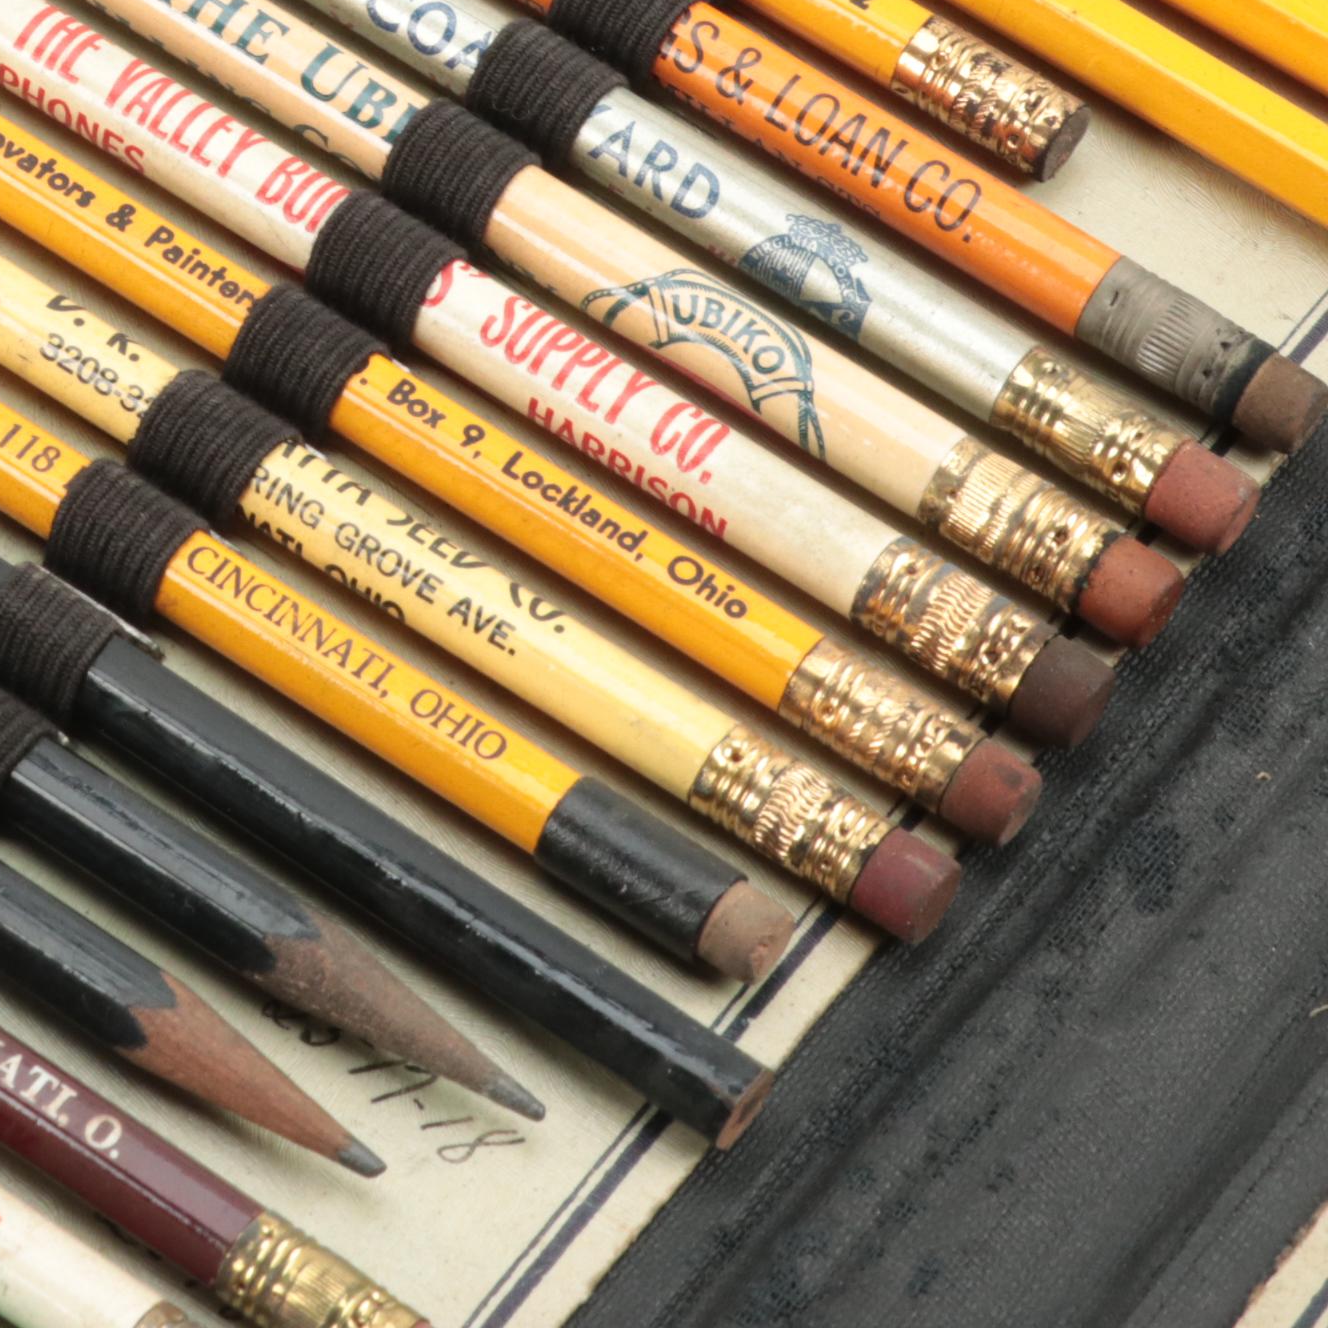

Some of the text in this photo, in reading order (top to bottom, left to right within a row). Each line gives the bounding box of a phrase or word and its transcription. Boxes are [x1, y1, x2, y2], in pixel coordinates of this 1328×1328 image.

[299, 42, 422, 142] UBI
[586, 105, 721, 220] ARD
[715, 47, 763, 106] &
[763, 74, 909, 189] LOAN
[903, 159, 982, 243] CO.
[12, 4, 106, 84] THE
[104, 57, 271, 178] VALLEY
[479, 294, 660, 425] SUPPLY
[650, 401, 730, 485] CO.
[105, 203, 138, 233] &
[143, 224, 259, 312] Painter
[386, 378, 447, 431] Box
[460, 423, 486, 460] 9,
[500, 450, 649, 562] Lockland,
[666, 555, 749, 619] Ohio
[671, 292, 787, 375] UBIKO
[528, 397, 728, 538] HARRISON
[251, 465, 326, 531] RING
[333, 521, 444, 605] GROVE
[446, 596, 517, 656] AVE.
[186, 544, 397, 700] CINCINNATI,
[409, 688, 508, 762] OHIO
[83, 1113, 123, 1160] O.
